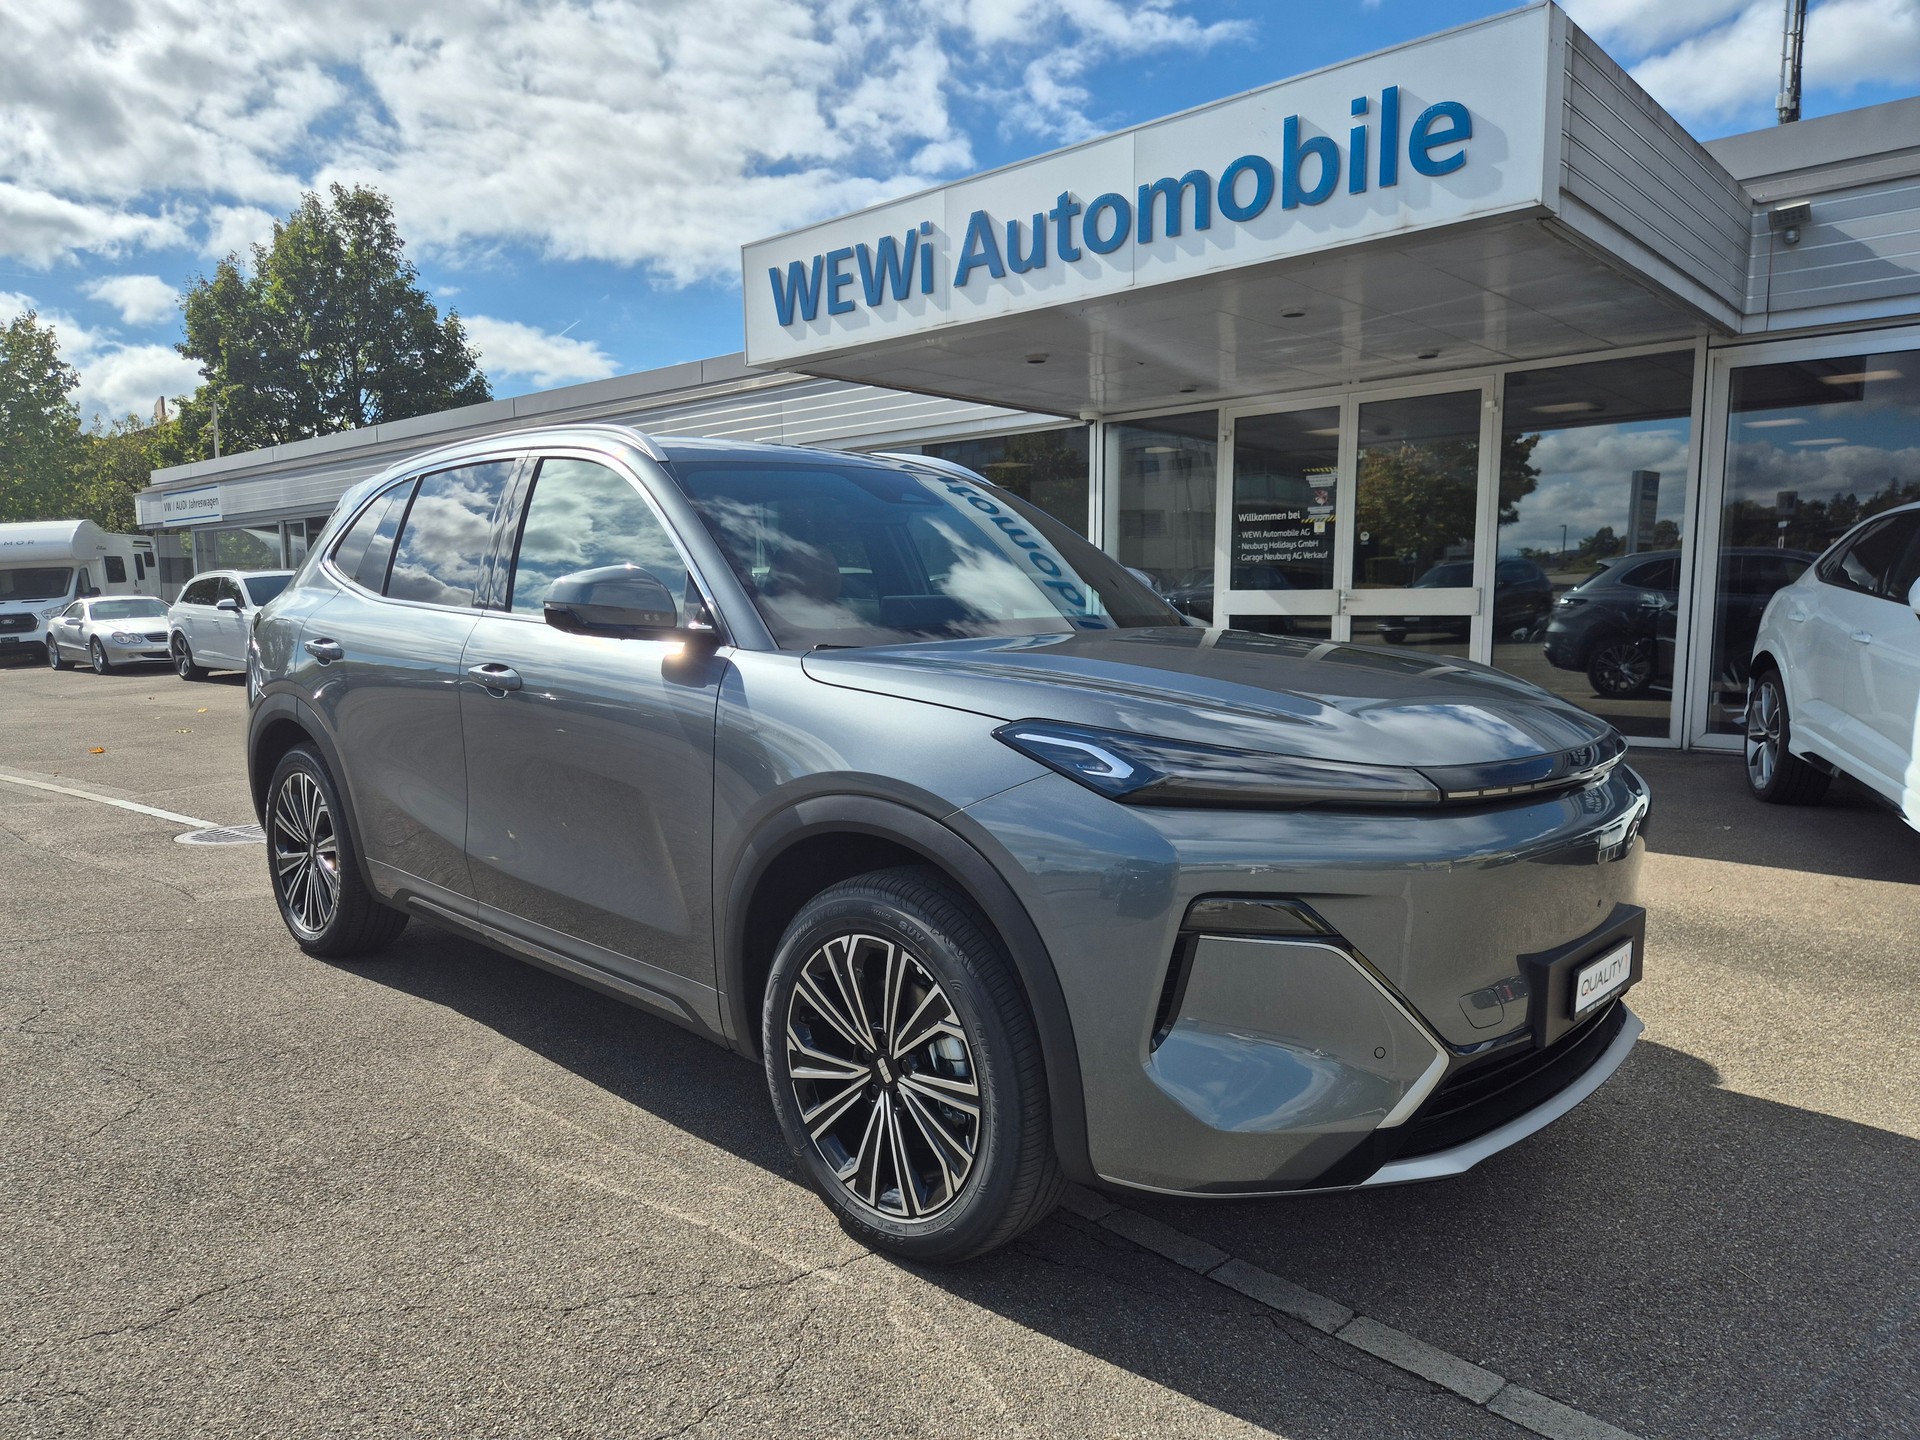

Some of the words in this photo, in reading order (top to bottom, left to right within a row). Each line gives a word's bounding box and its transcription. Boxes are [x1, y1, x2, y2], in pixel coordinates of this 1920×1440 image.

[768, 220, 934, 326] WEWi
[954, 84, 1472, 288] Automobile
[1238, 512, 1286, 522] Willkommen
[1288, 510, 1300, 520] bei
[1263, 529, 1299, 538] Automobile
[1300, 528, 1311, 536] AG
[1241, 542, 1268, 551] Neuburg
[1269, 540, 1297, 550] Holidays
[1298, 539, 1319, 548] GmbH
[1241, 553, 1263, 563] Garage
[1264, 552, 1291, 561] Neuburg
[1292, 551, 1302, 560] AG
[1303, 550, 1329, 559] Verkauf
[898, 920, 925, 943] SUV
